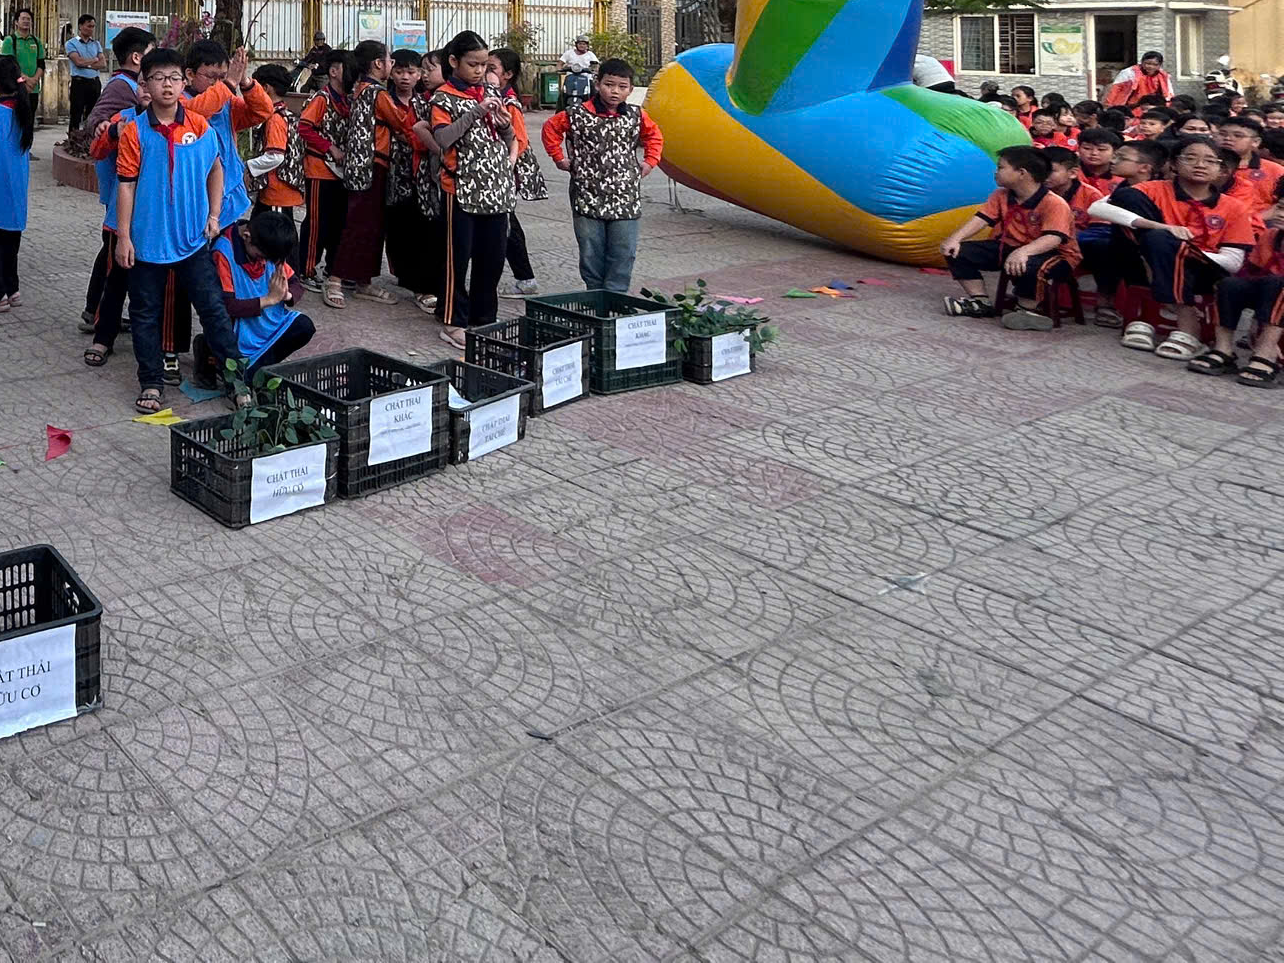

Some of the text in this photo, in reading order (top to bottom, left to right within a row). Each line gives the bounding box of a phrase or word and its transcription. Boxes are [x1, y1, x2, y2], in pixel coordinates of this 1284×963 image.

[385, 399, 405, 412] CHẤT
[394, 410, 413, 423] KHÁC
[267, 464, 309, 484] CHẤT THẢI
[17, 659, 52, 679] THẢI
[20, 683, 41, 700] CƠ
